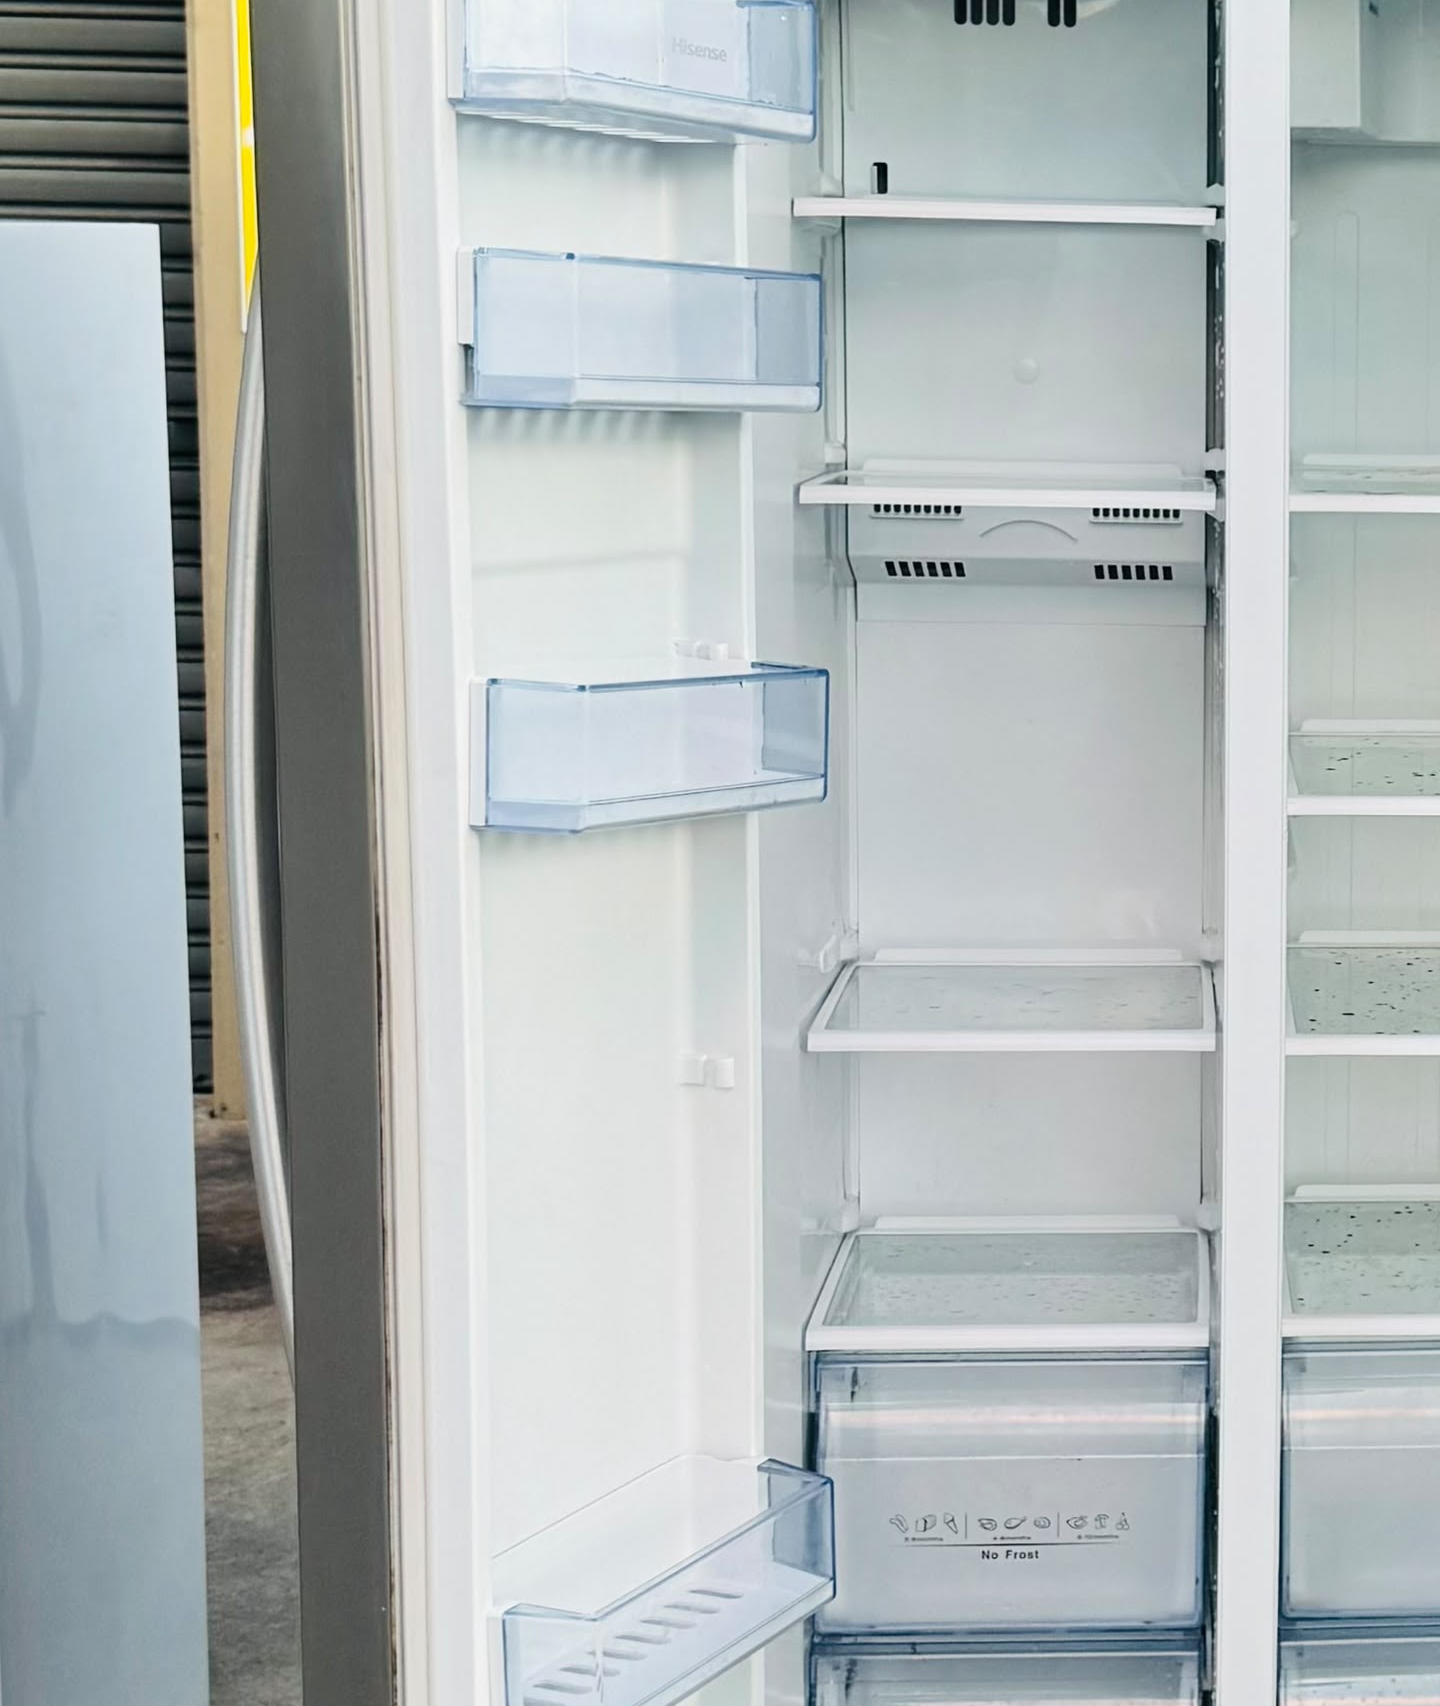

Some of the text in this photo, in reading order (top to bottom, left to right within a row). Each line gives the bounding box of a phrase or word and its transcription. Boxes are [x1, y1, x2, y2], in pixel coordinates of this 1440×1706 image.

[672, 36, 728, 62] Hisense
[981, 1549, 1039, 1560] No Frost
